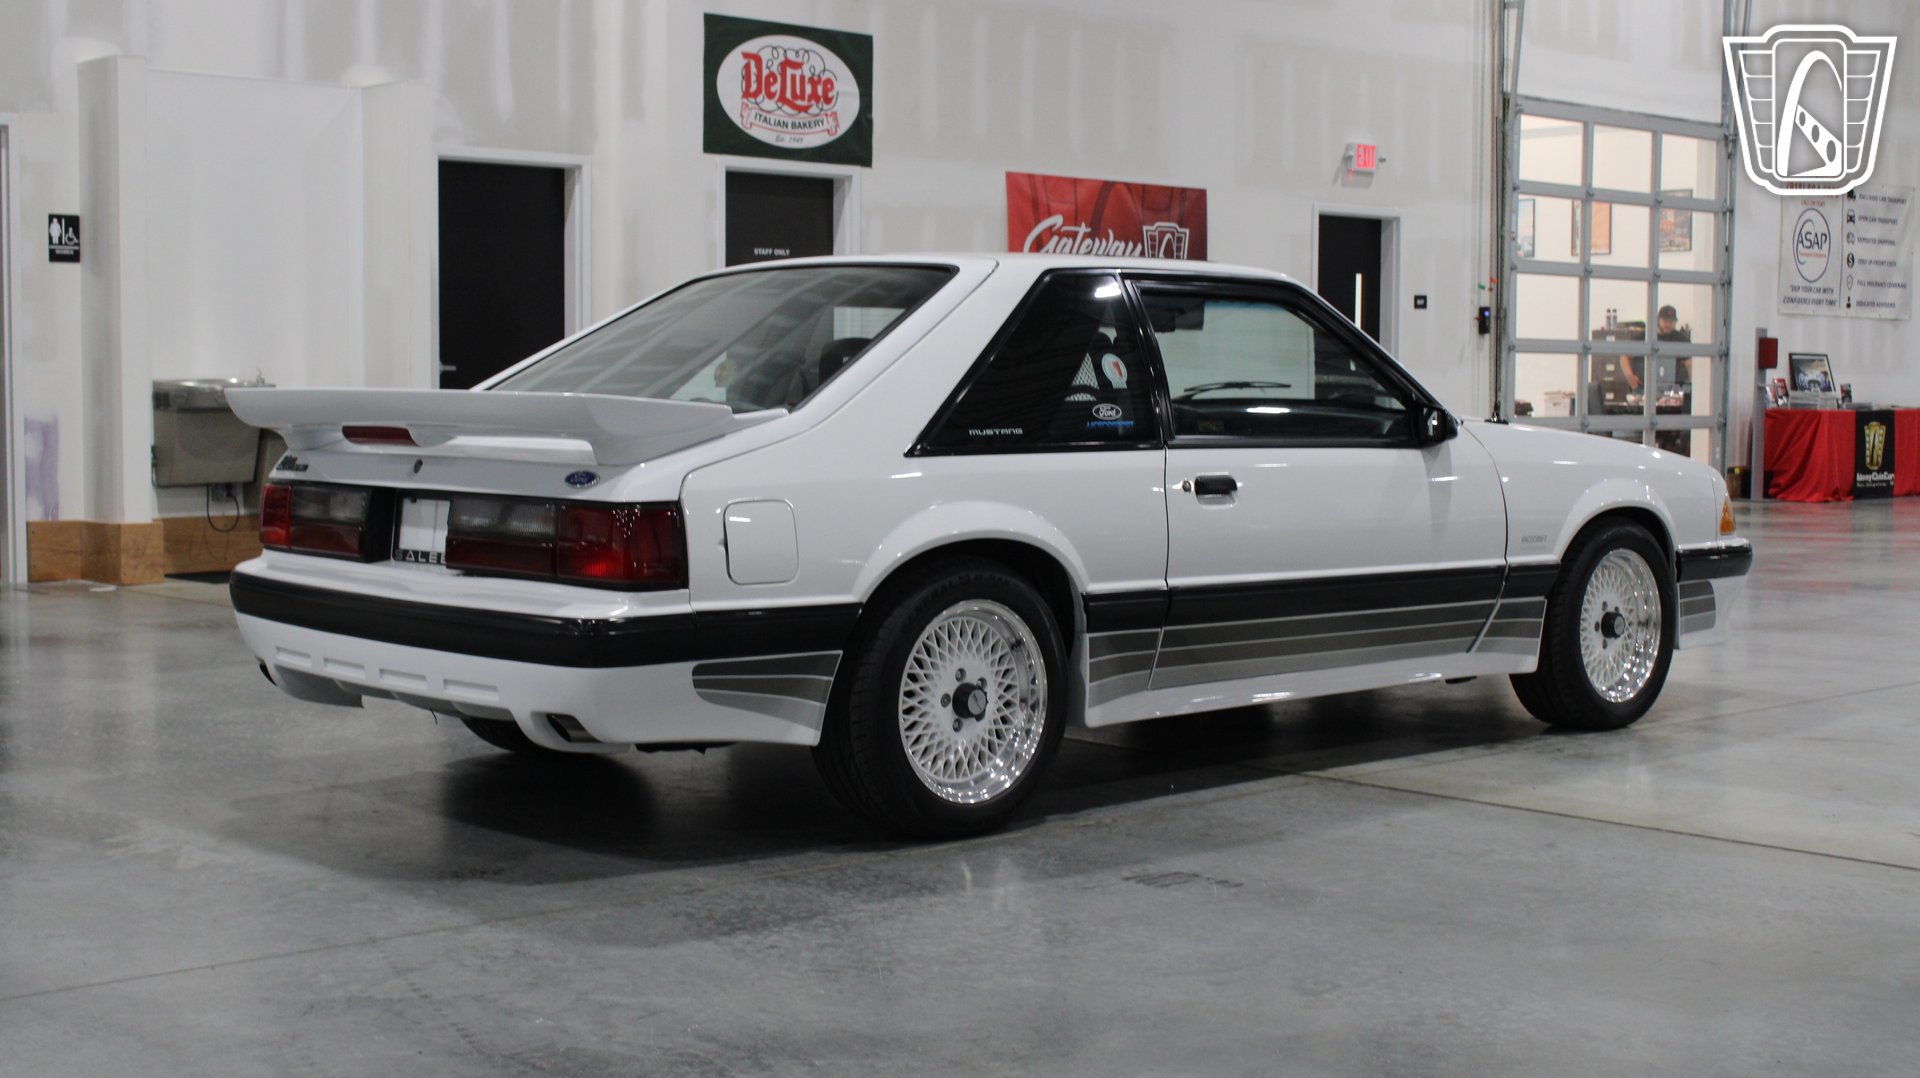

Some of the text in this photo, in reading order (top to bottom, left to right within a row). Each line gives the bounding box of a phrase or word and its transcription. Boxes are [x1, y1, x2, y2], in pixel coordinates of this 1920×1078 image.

[741, 52, 835, 112] DeLuxe
[754, 113, 826, 131] ITALIAN BAKERY
[1357, 144, 1376, 169] EXIT
[1023, 214, 1142, 256] Gateway
[1798, 231, 1828, 250] ASAP
[754, 247, 791, 256] STAFF ONLY
[969, 427, 1024, 436] MUSTANG
